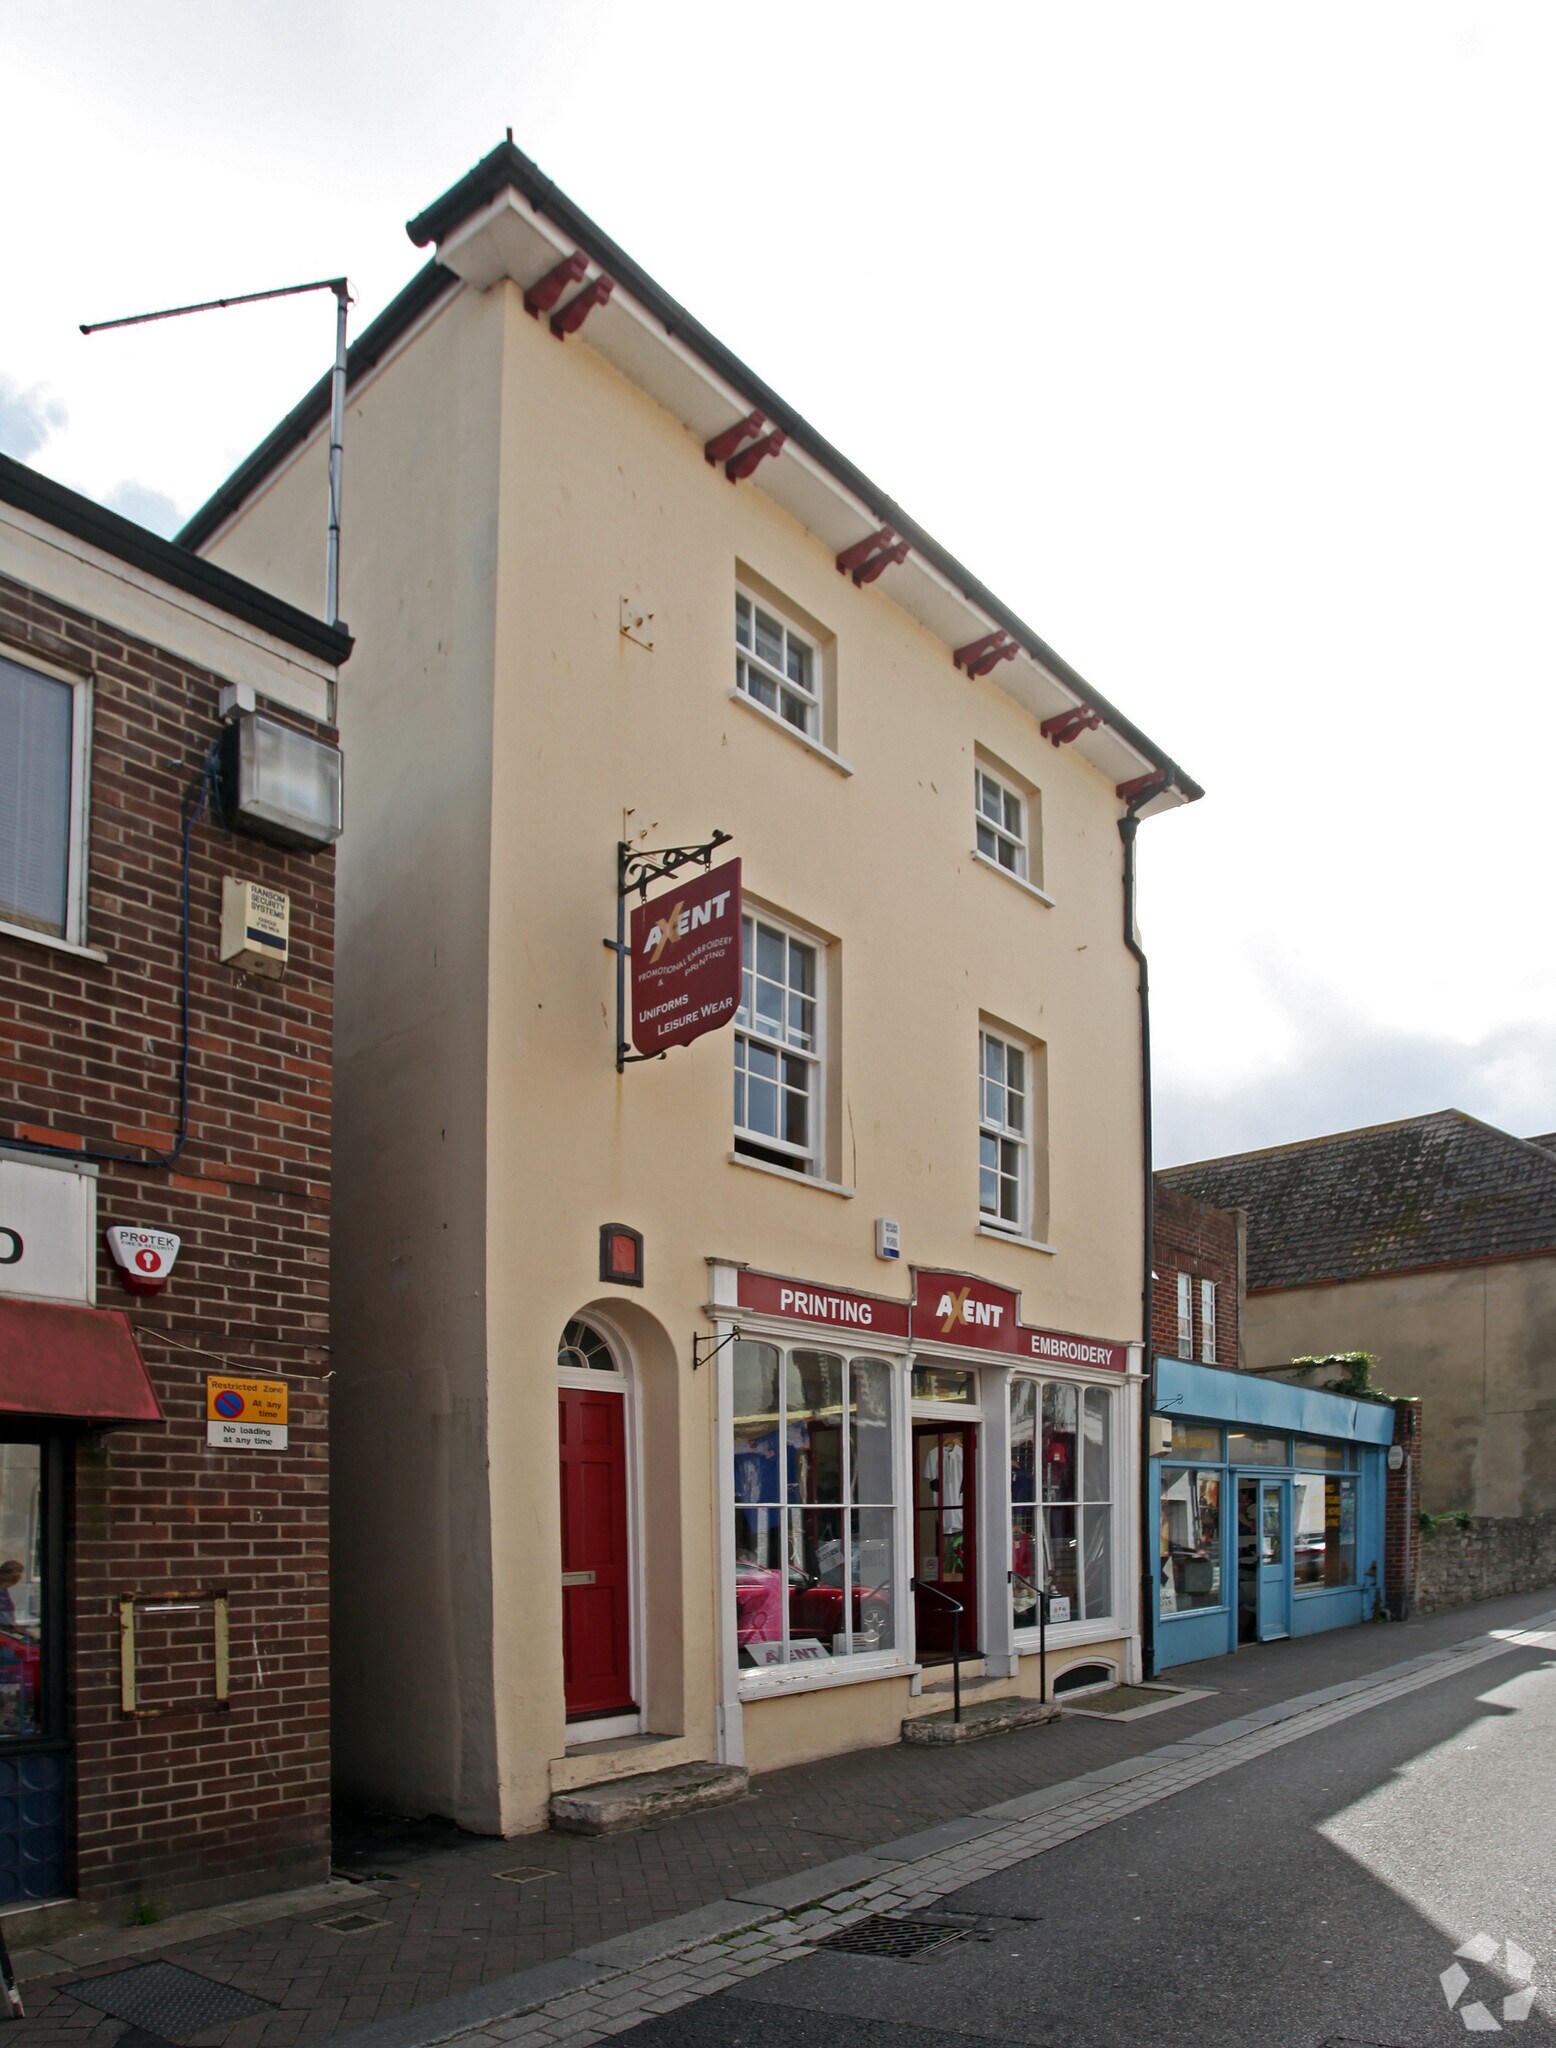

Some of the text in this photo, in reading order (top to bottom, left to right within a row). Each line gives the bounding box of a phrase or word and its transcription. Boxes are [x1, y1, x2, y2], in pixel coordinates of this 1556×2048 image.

[251, 885, 285, 903] RANSOM
[251, 893, 284, 911] SECURITY
[251, 902, 284, 920] SYSTEMS
[642, 890, 731, 965] AXENT
[638, 936, 733, 982] PROMOTIONAL EMBROIDERY
[684, 949, 726, 976] PRINTING
[639, 994, 689, 1022] UNIFORMS
[657, 997, 733, 1036] LEISURE WEAR
[120, 1231, 175, 1247] PROTEK
[780, 1288, 872, 1325] PRINTING
[935, 1286, 1004, 1334] AXENT
[1031, 1335, 1113, 1365] EMBROIDERY
[211, 1381, 283, 1393] Restricted Zone
[266, 1401, 282, 1409] any
[223, 1425, 271, 1436] No loading
[235, 1437, 251, 1445] any
[765, 1647, 820, 1664] AENT
